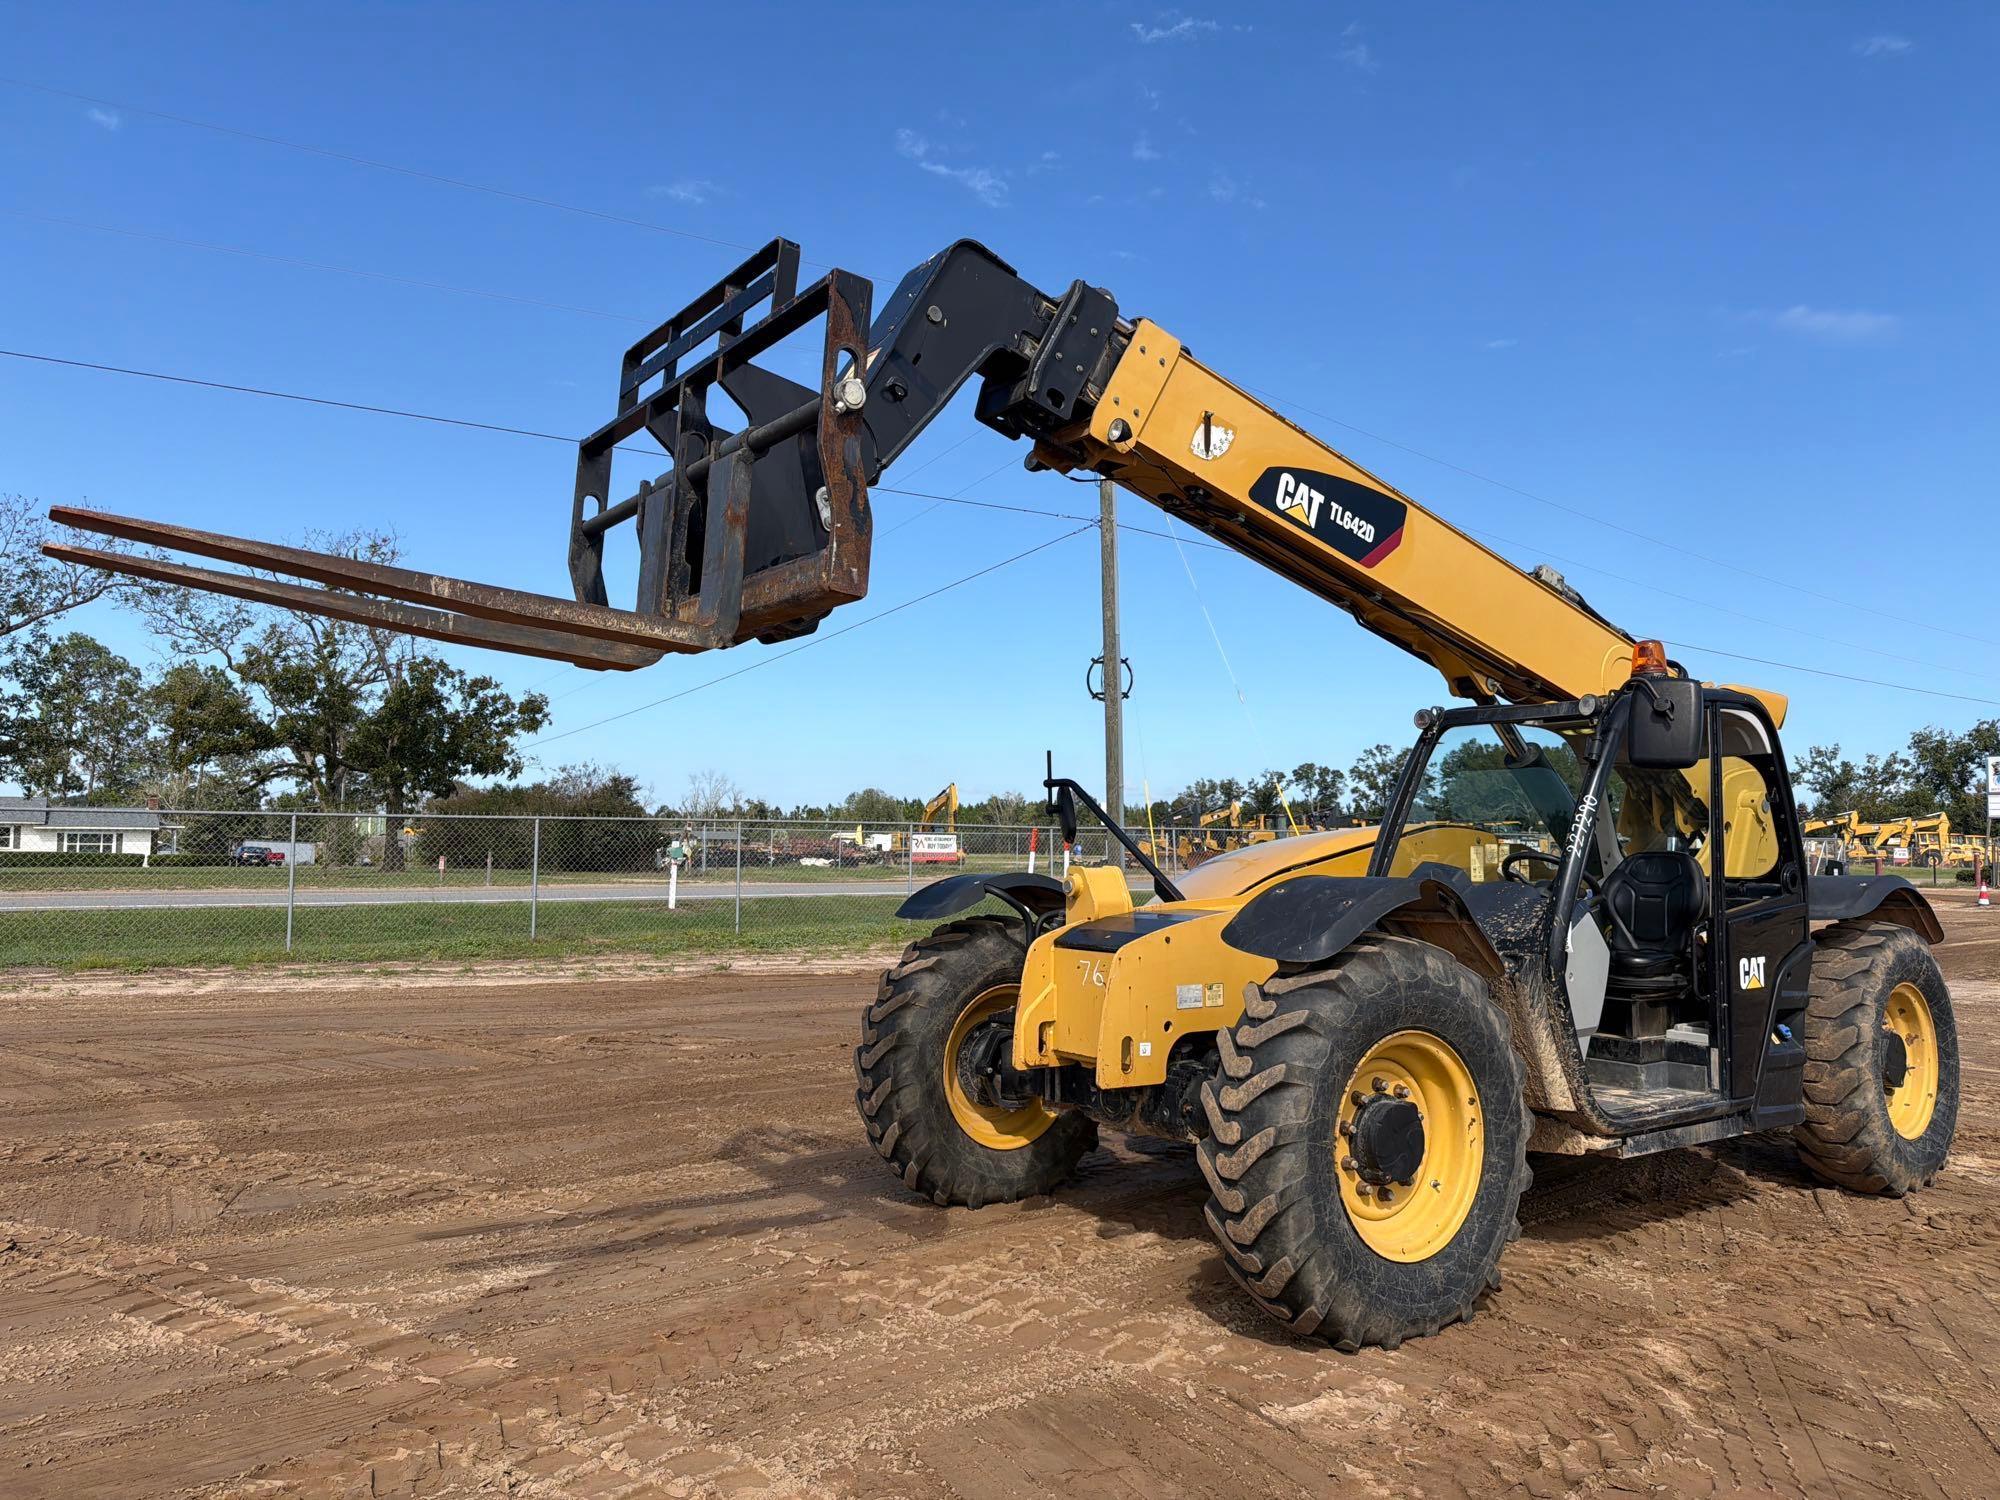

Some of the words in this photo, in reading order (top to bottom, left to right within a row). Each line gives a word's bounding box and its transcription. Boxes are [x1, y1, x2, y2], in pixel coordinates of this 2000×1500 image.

[1275, 472, 1325, 529] CAT
[1330, 501, 1375, 543] TL642D
[1079, 959, 1104, 986] 76
[1739, 956, 1766, 990] CAT
